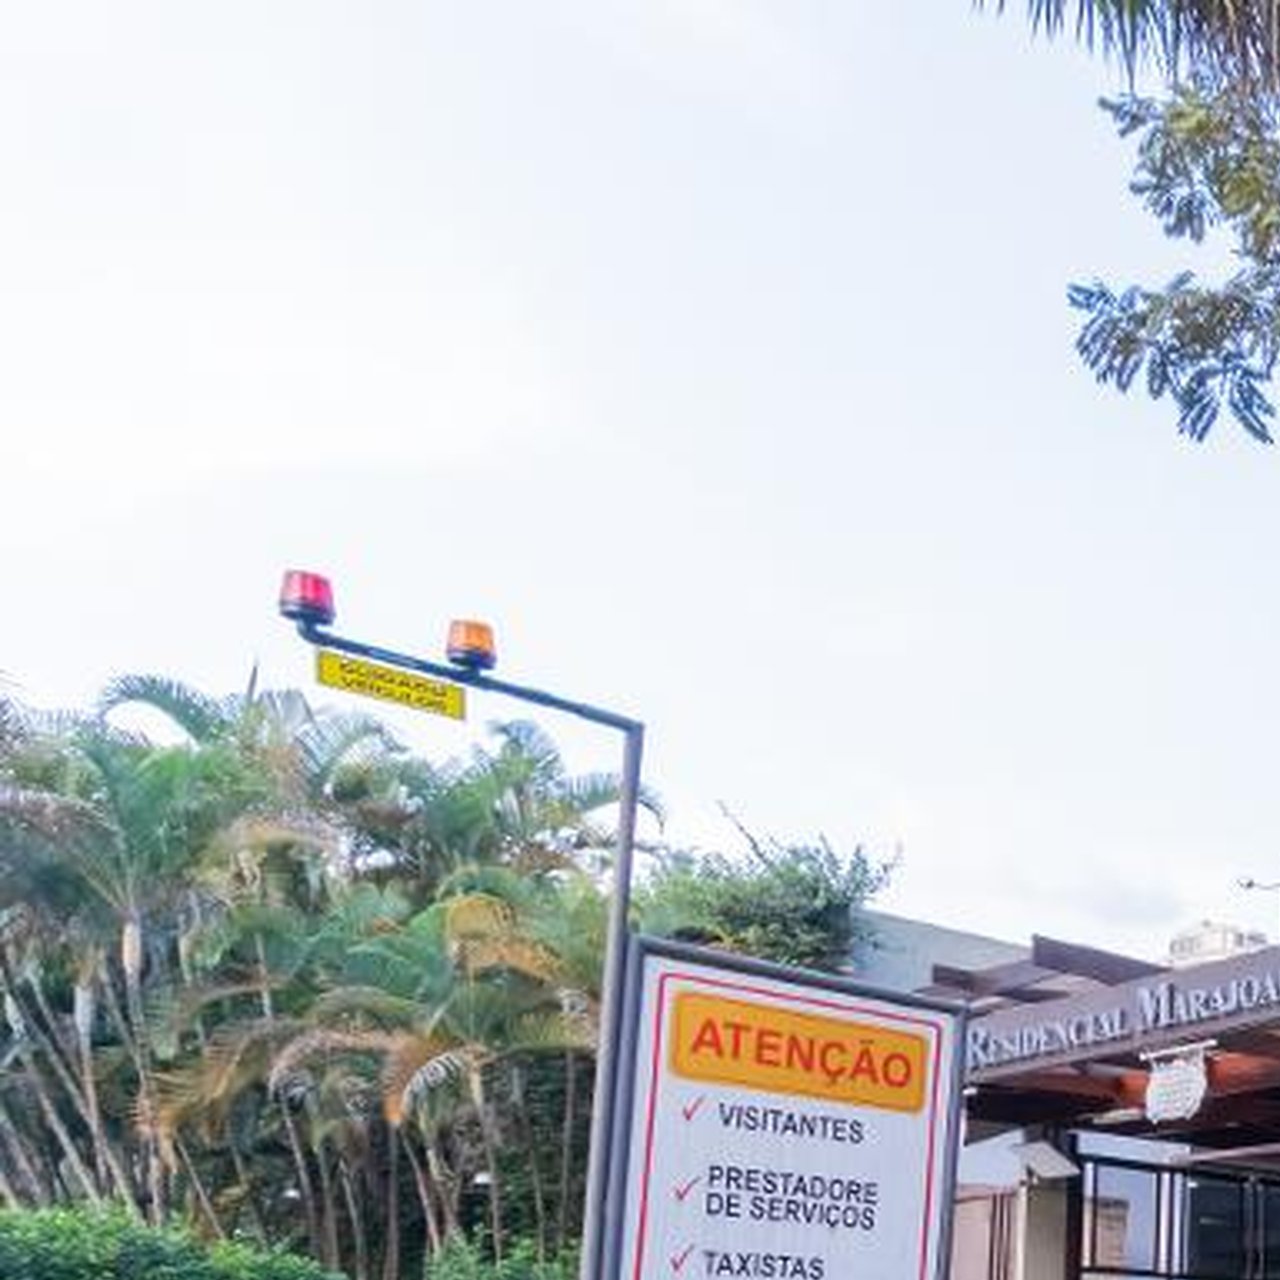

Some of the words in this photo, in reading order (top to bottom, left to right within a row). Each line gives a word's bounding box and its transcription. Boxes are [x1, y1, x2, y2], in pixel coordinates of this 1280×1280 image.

[690, 1017, 912, 1088] ATENÇÃO
[966, 1008, 1127, 1067] RESIDENCIAL
[719, 1102, 864, 1144] VISITANTES
[706, 1193, 741, 1218] DE
[750, 1196, 875, 1231] SERVIÇOS
[703, 1251, 825, 1280] TAXISTAS
